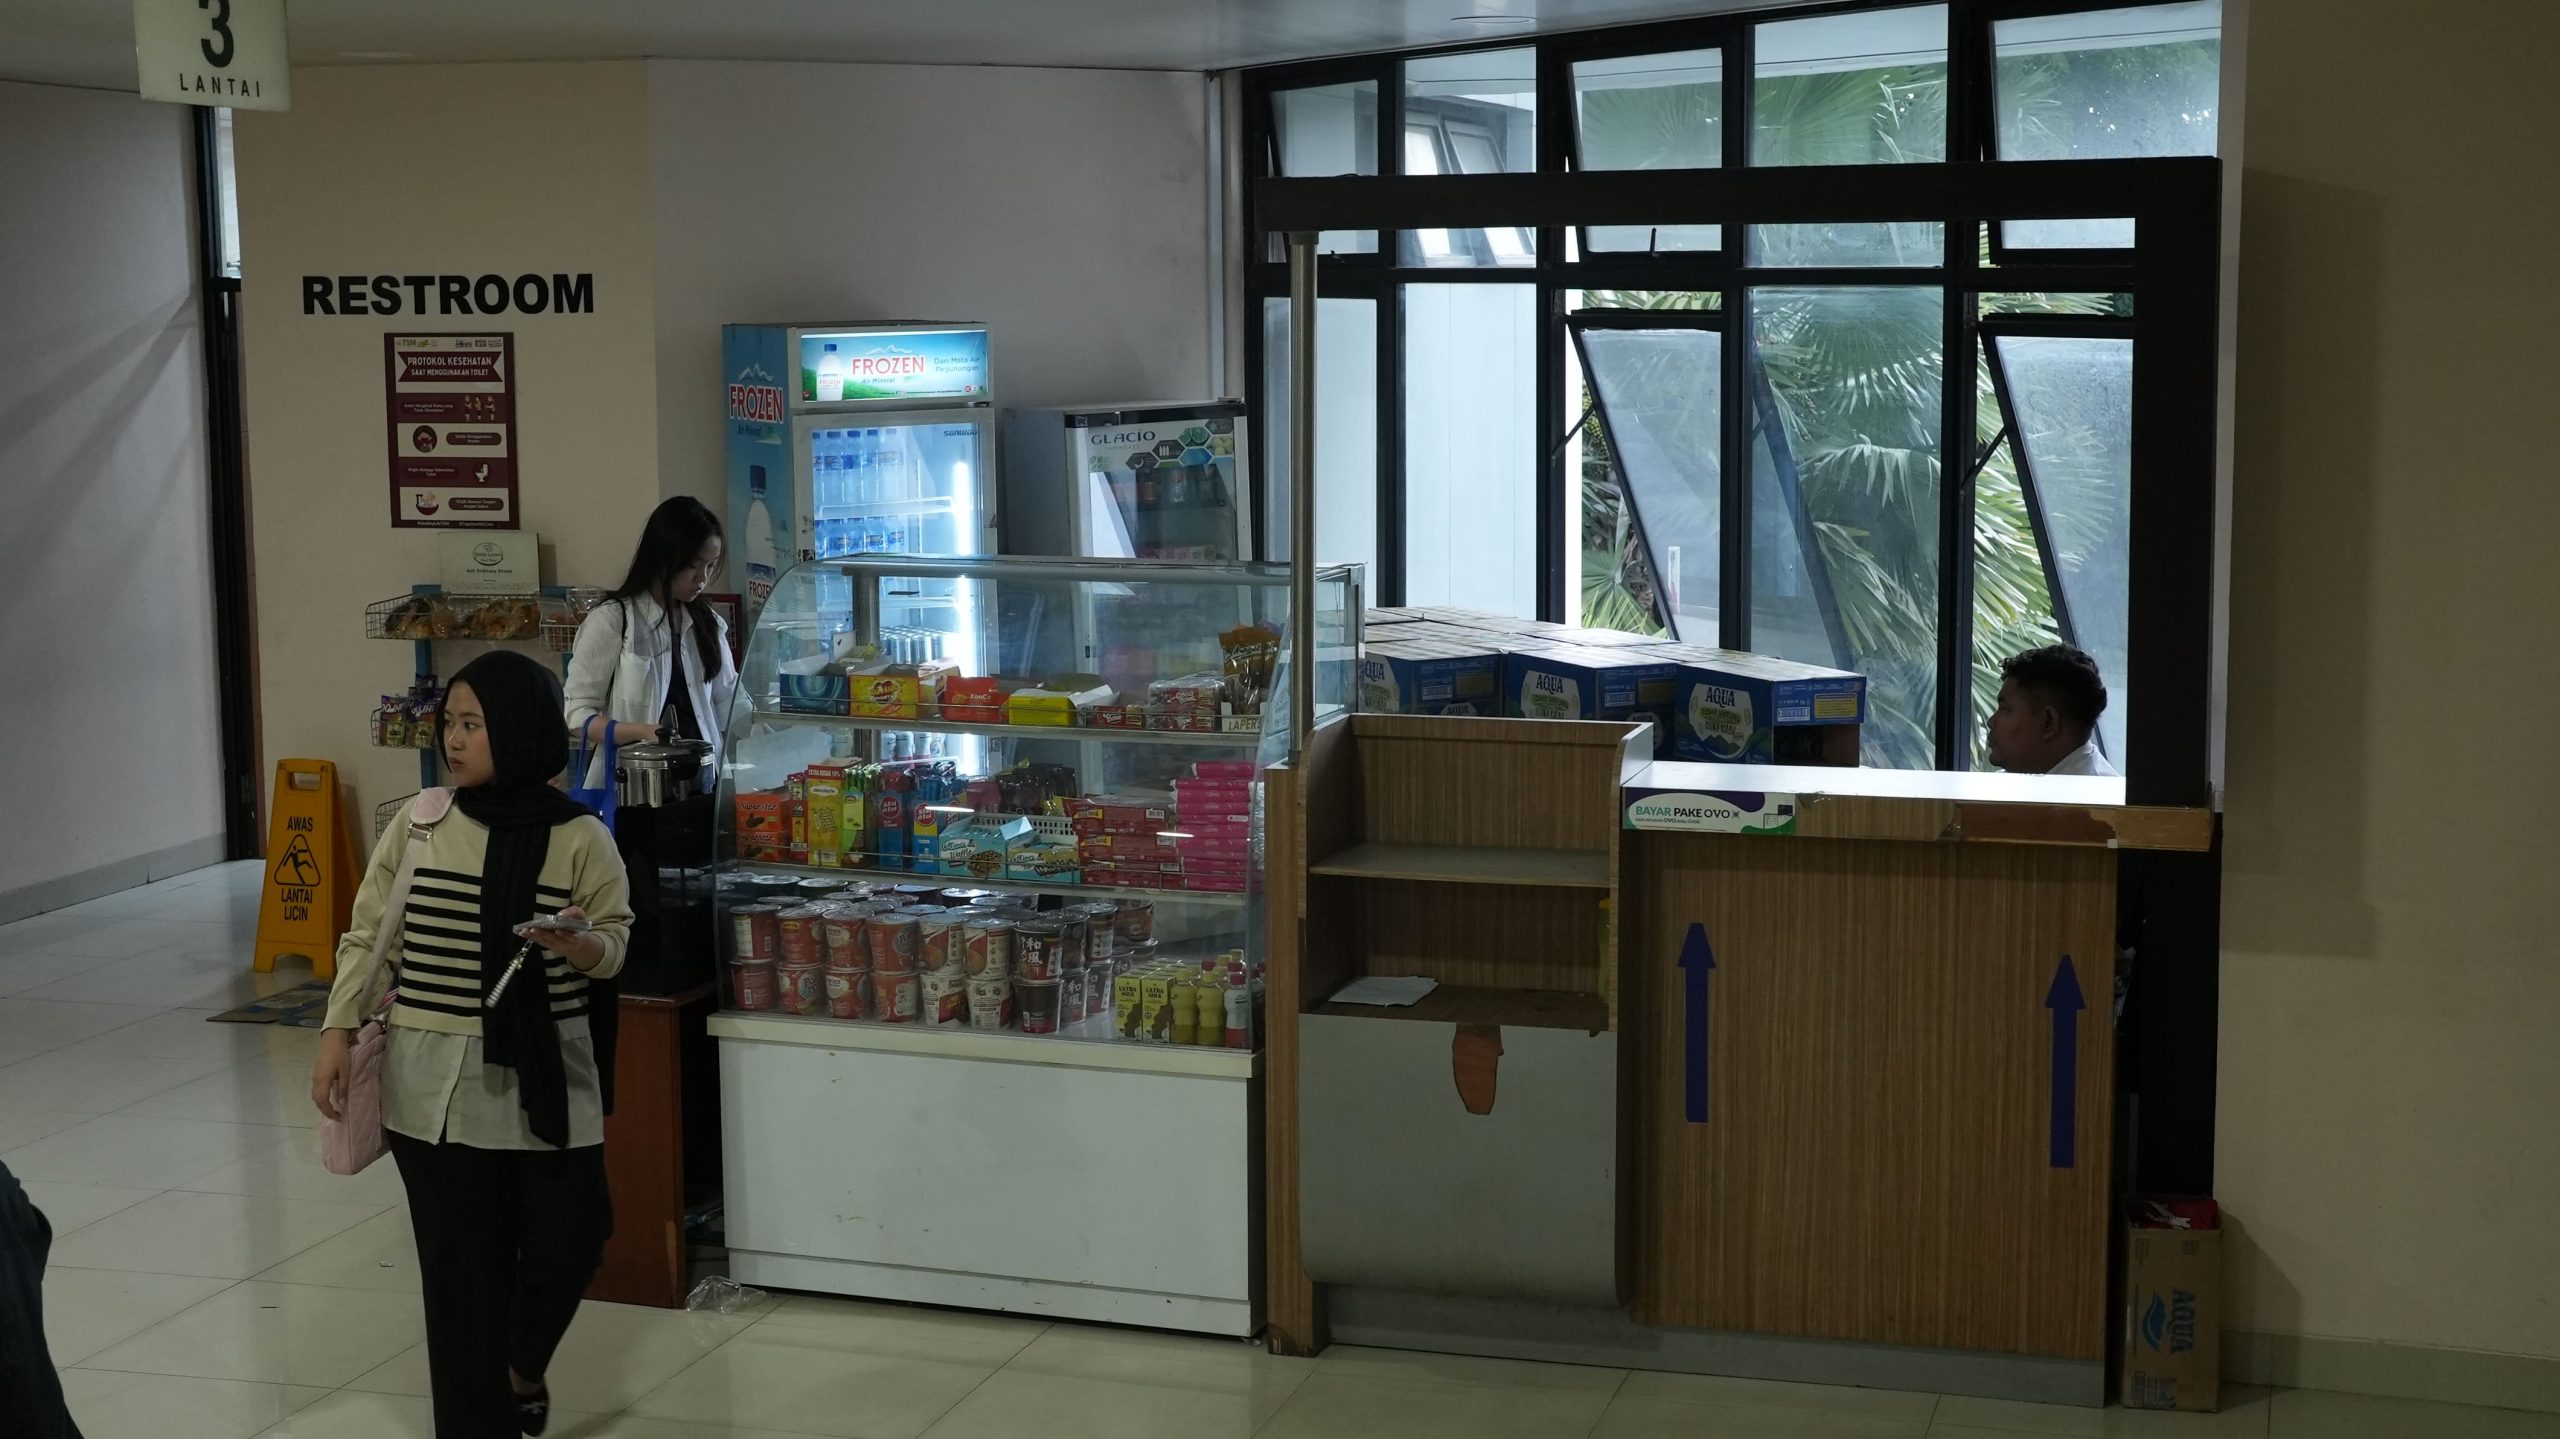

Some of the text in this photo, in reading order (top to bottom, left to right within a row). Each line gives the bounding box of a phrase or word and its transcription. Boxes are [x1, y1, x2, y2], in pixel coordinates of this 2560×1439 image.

[200, 0, 234, 68] 3
[179, 73, 261, 98] LANTAI
[302, 273, 594, 316] RESTROOM
[407, 356, 492, 366] PROTOKOL KESEHATAN
[851, 356, 926, 376] FROZEN
[935, 364, 980, 373] Pegunungan
[951, 356, 967, 364] Mata
[970, 356, 980, 364] Air
[729, 384, 784, 423] FROZEN
[749, 581, 773, 599] FROZE
[1364, 660, 1386, 682] QUA
[1536, 673, 1564, 695] AQUA
[1705, 686, 1736, 708] AQUA
[1635, 805, 1731, 819] BAYAR PAKE OVO
[287, 816, 314, 833] AWAS
[281, 887, 313, 904] LANTAI
[284, 905, 309, 921] LICIN
[1026, 937, 1043, 964] 和風
[1067, 980, 1082, 1006] 和風
[2167, 1288, 2196, 1354] AQUA
